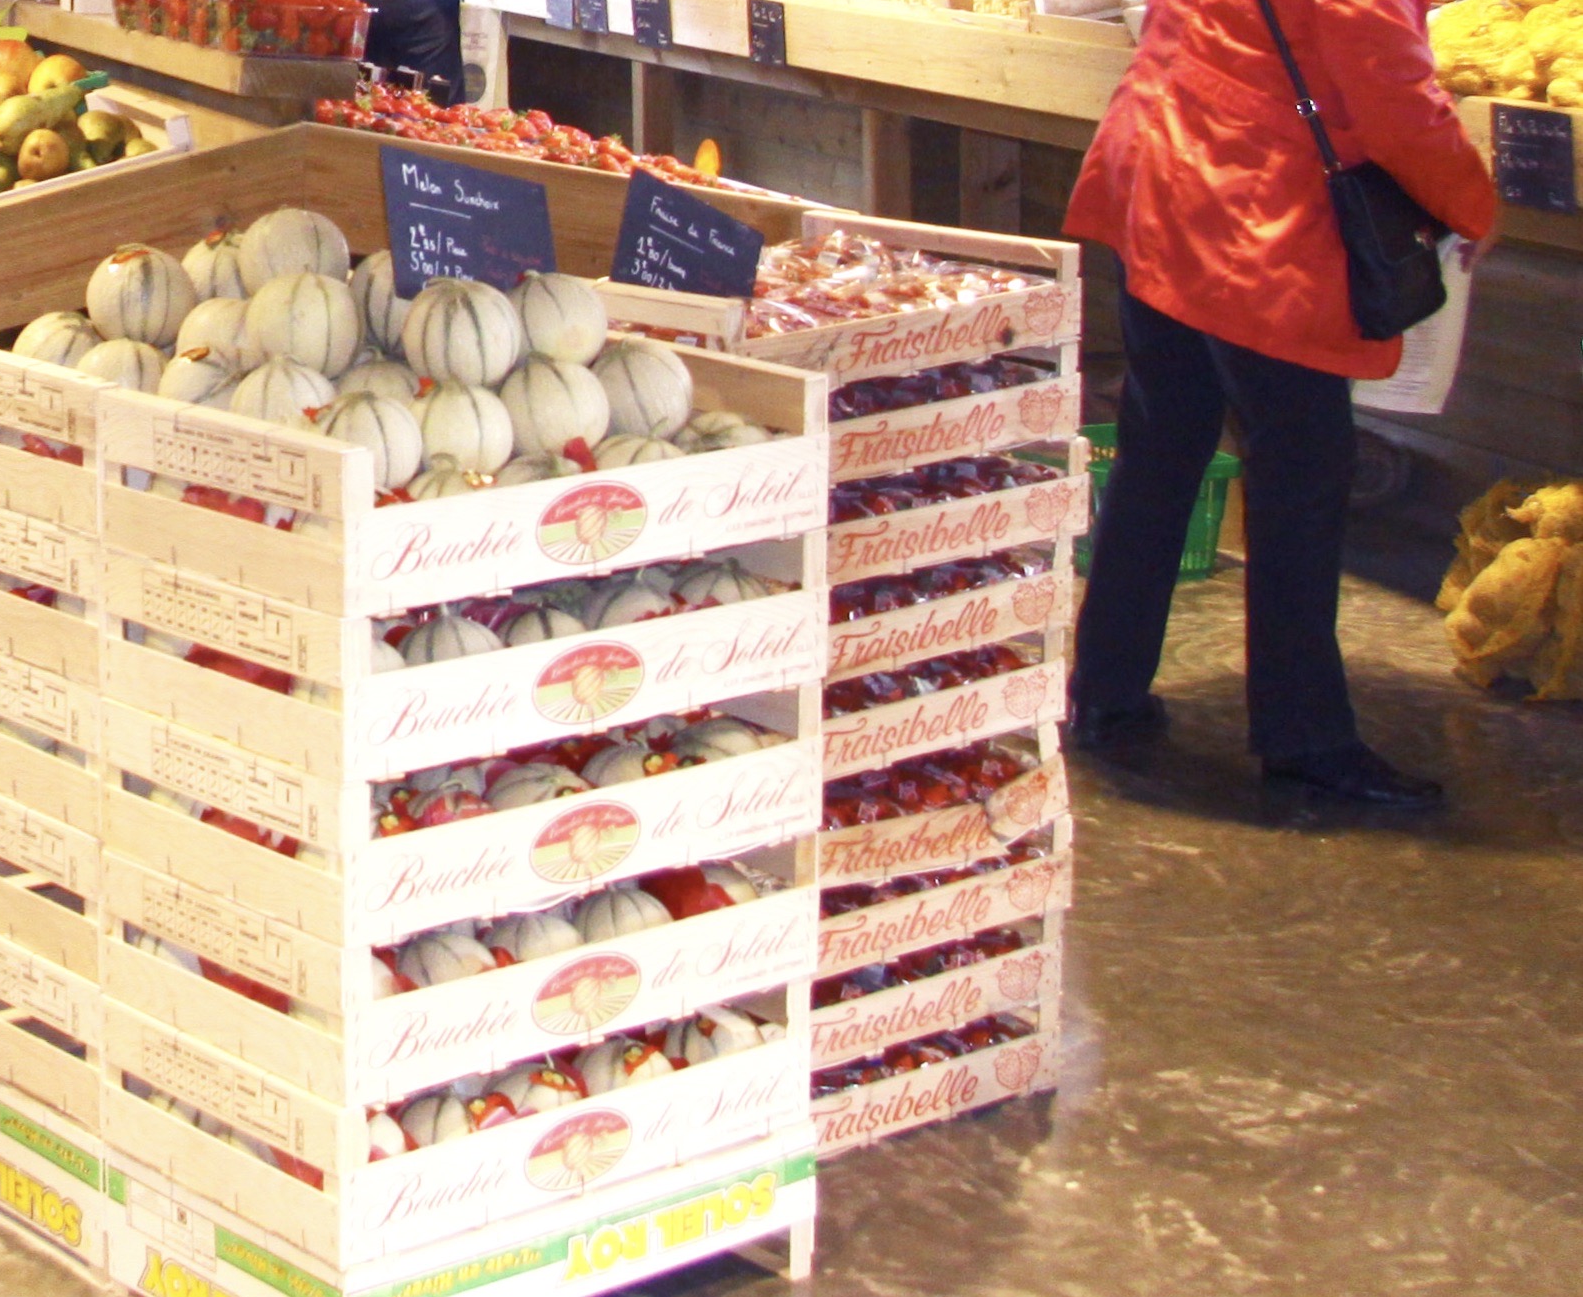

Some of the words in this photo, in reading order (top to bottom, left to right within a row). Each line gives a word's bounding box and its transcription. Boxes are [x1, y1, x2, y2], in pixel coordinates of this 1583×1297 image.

[402, 163, 442, 194] Melon
[835, 304, 1011, 371] Fraisibelle
[830, 402, 1005, 472] Fraisibelle
[657, 486, 693, 525] de
[829, 501, 1011, 574] Fraisibelle
[655, 646, 692, 683] de
[829, 598, 998, 670] Fraisibelle
[822, 694, 988, 764] Fraisibelle
[651, 799, 685, 839] de
[819, 813, 992, 876] Fraisibelle
[819, 884, 991, 966] Fraisibelle
[651, 951, 686, 990] de
[643, 1106, 677, 1143] de
[656, 1173, 778, 1249] SOLEIL
[563, 1219, 648, 1281] ROY
